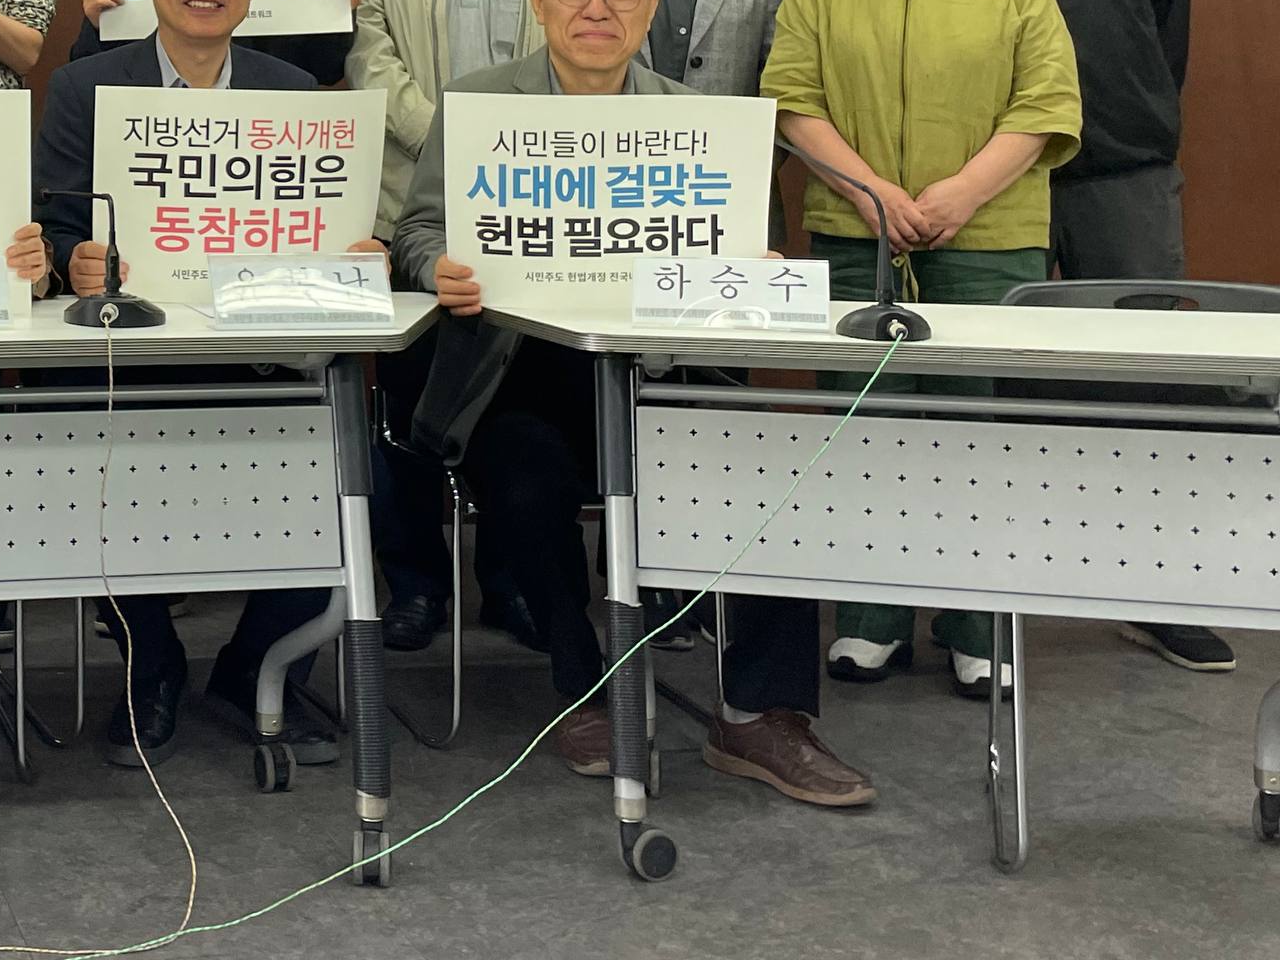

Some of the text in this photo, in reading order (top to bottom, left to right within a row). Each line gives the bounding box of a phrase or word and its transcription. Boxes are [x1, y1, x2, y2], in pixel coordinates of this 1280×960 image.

[124, 116, 356, 151] 지방선거 동시개헌
[492, 129, 708, 159] 시민들이 바란다!
[128, 152, 348, 201] 국민의힘은
[467, 164, 732, 209] 시대에 걸맞는
[150, 206, 326, 254] 동참하라
[475, 214, 724, 258] 헌법 필요하다
[171, 269, 208, 280] 시민주도
[525, 271, 564, 283] 시민주도
[567, 271, 607, 283] 헌법개정
